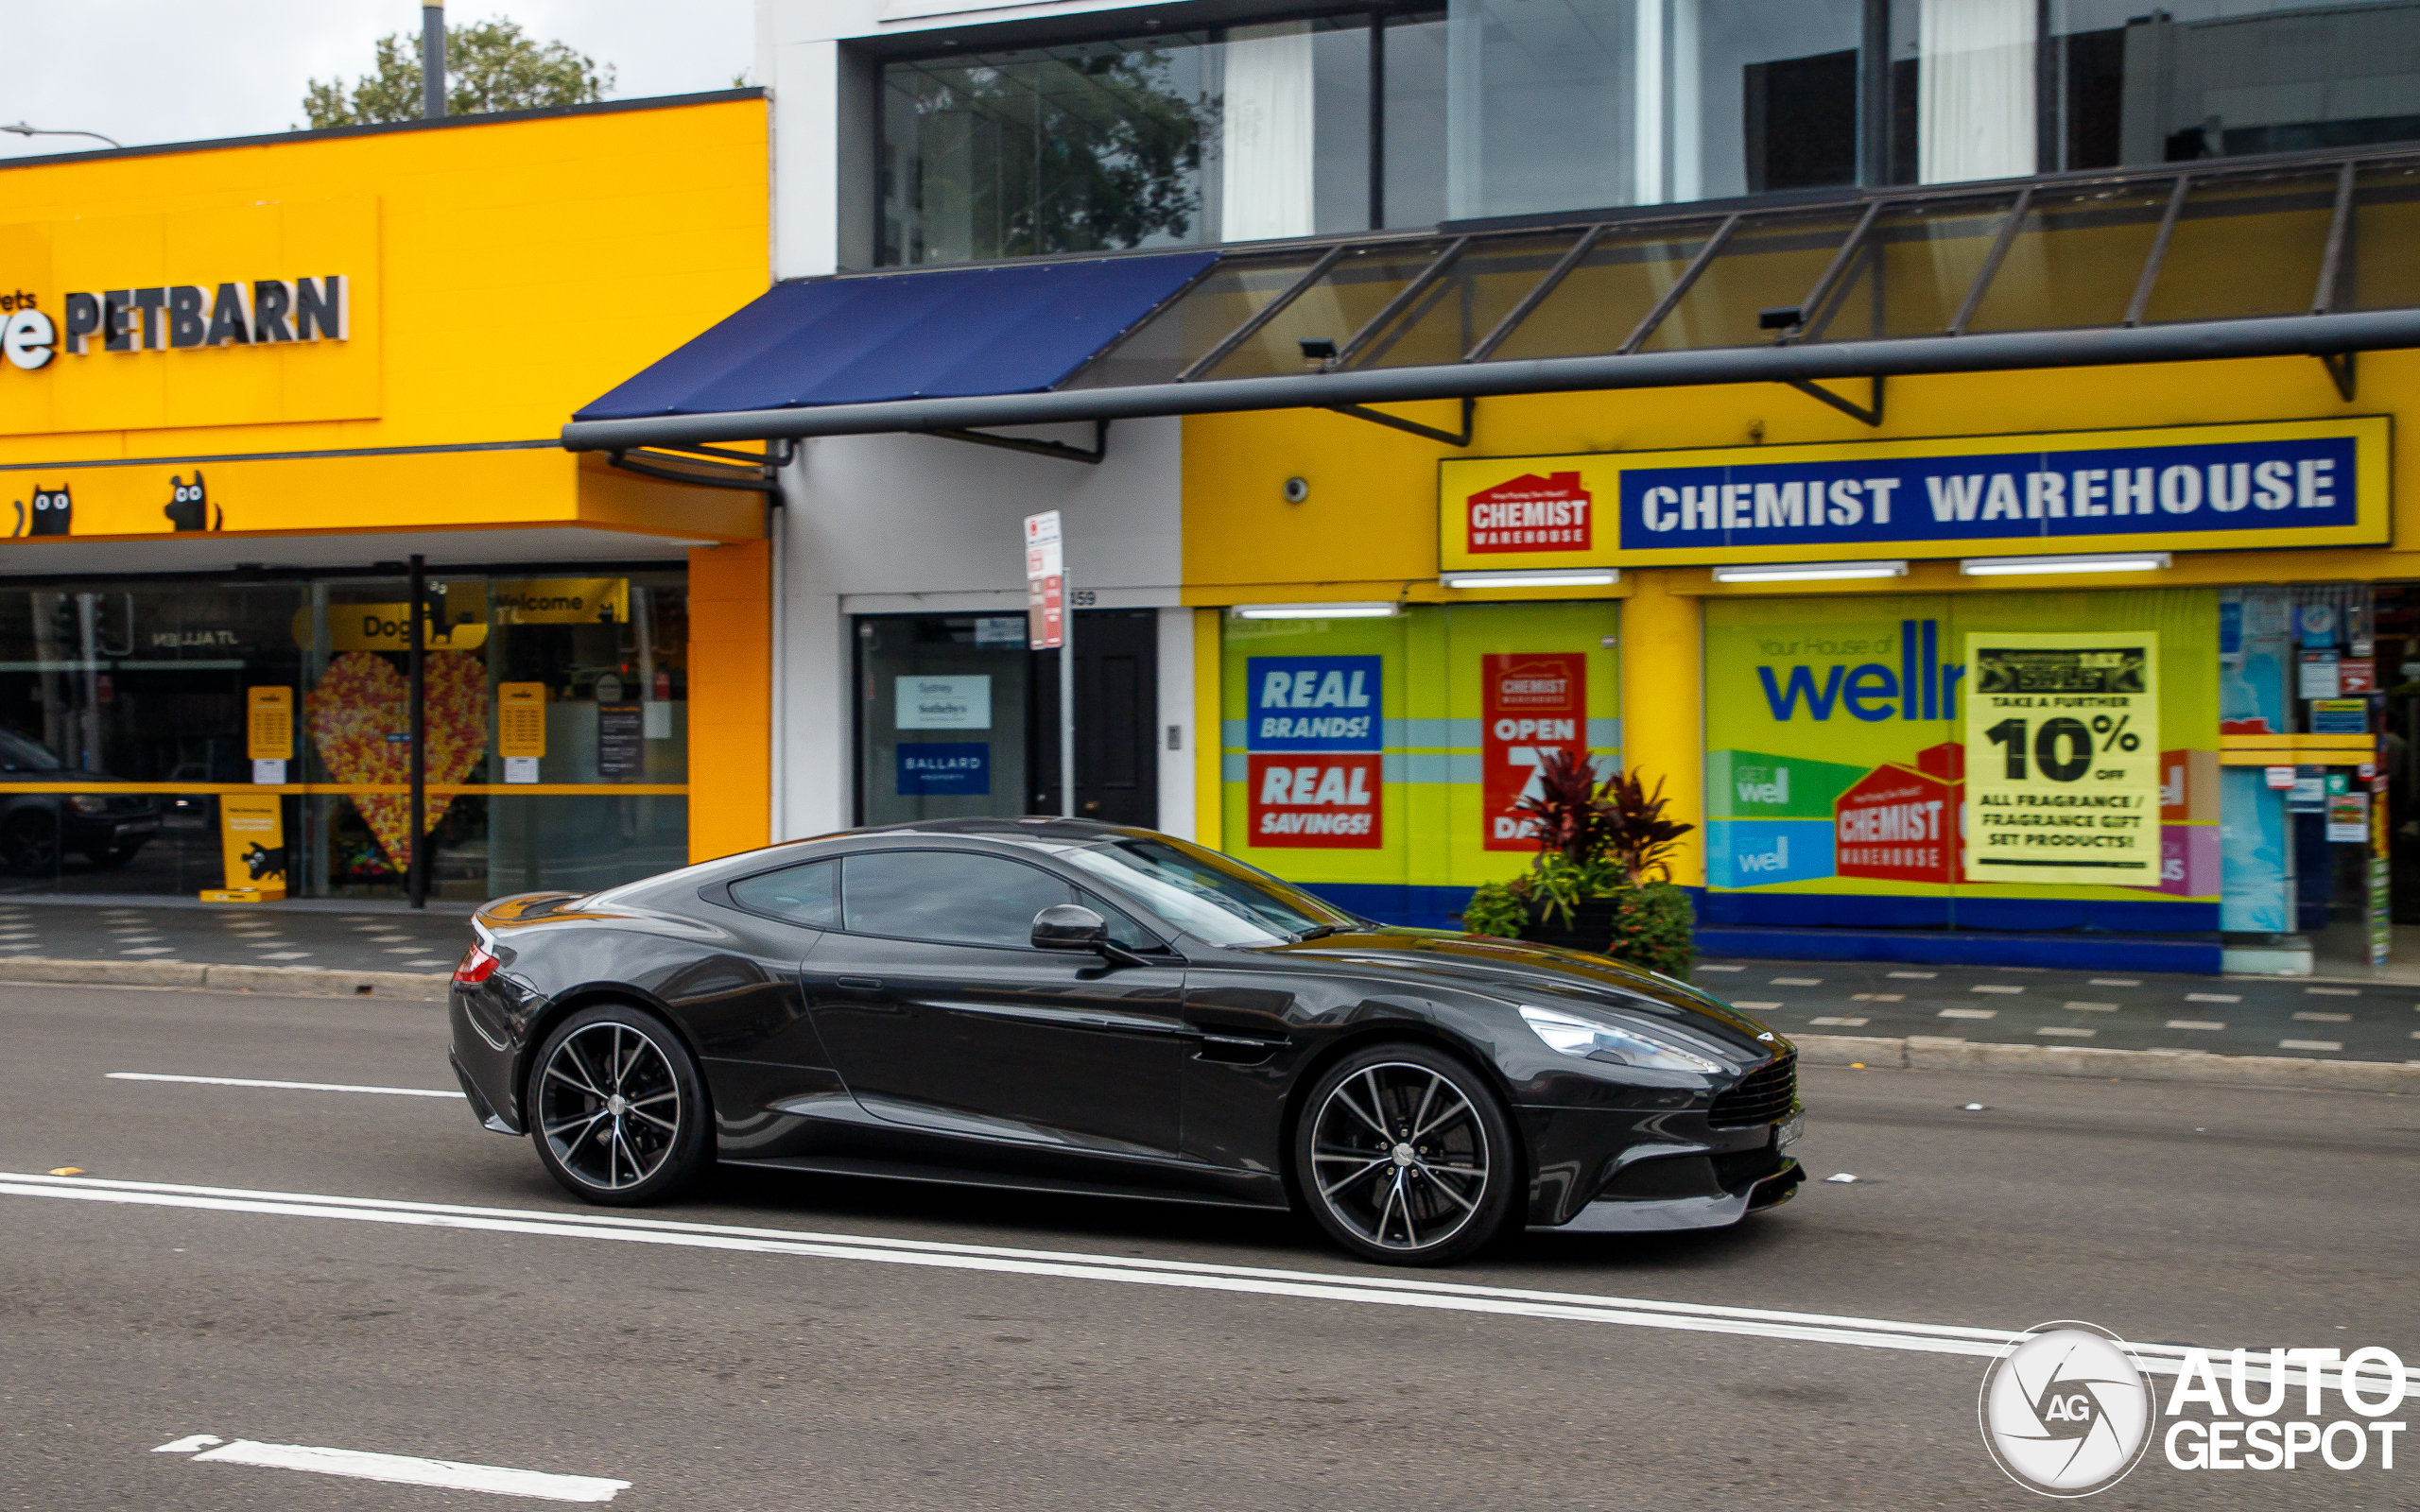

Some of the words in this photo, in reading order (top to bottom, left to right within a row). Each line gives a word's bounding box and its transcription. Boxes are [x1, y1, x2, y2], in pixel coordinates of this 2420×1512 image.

[0, 289, 36, 311] ets
[64, 274, 349, 355] PETBARN
[1642, 478, 1900, 532] CHEMIST
[1925, 458, 2336, 523] WAREHOUSE
[1472, 499, 1588, 529] CHEMIST
[1473, 528, 1584, 545] WAREHOUSE
[1260, 670, 1372, 709] REAL
[1991, 697, 2032, 707] TAKE
[2037, 697, 2049, 707] A
[2053, 697, 2130, 707] FURTHER
[1259, 715, 1372, 739] BRANDS!
[1494, 718, 1576, 741] OPEN
[1984, 714, 2141, 782] 10%
[905, 757, 981, 770] BALLARD
[2096, 770, 2126, 780] OFF
[1260, 766, 1373, 805] REAL
[1980, 795, 2012, 806] ALL
[2016, 795, 2131, 808] FRAGRANCE
[1259, 813, 1373, 836] SAVINGS!
[1839, 800, 1944, 842] CHEMIST
[1982, 814, 2096, 828] FRAGRANCE
[2100, 816, 2142, 828] GIFT
[1988, 833, 2020, 845] SET
